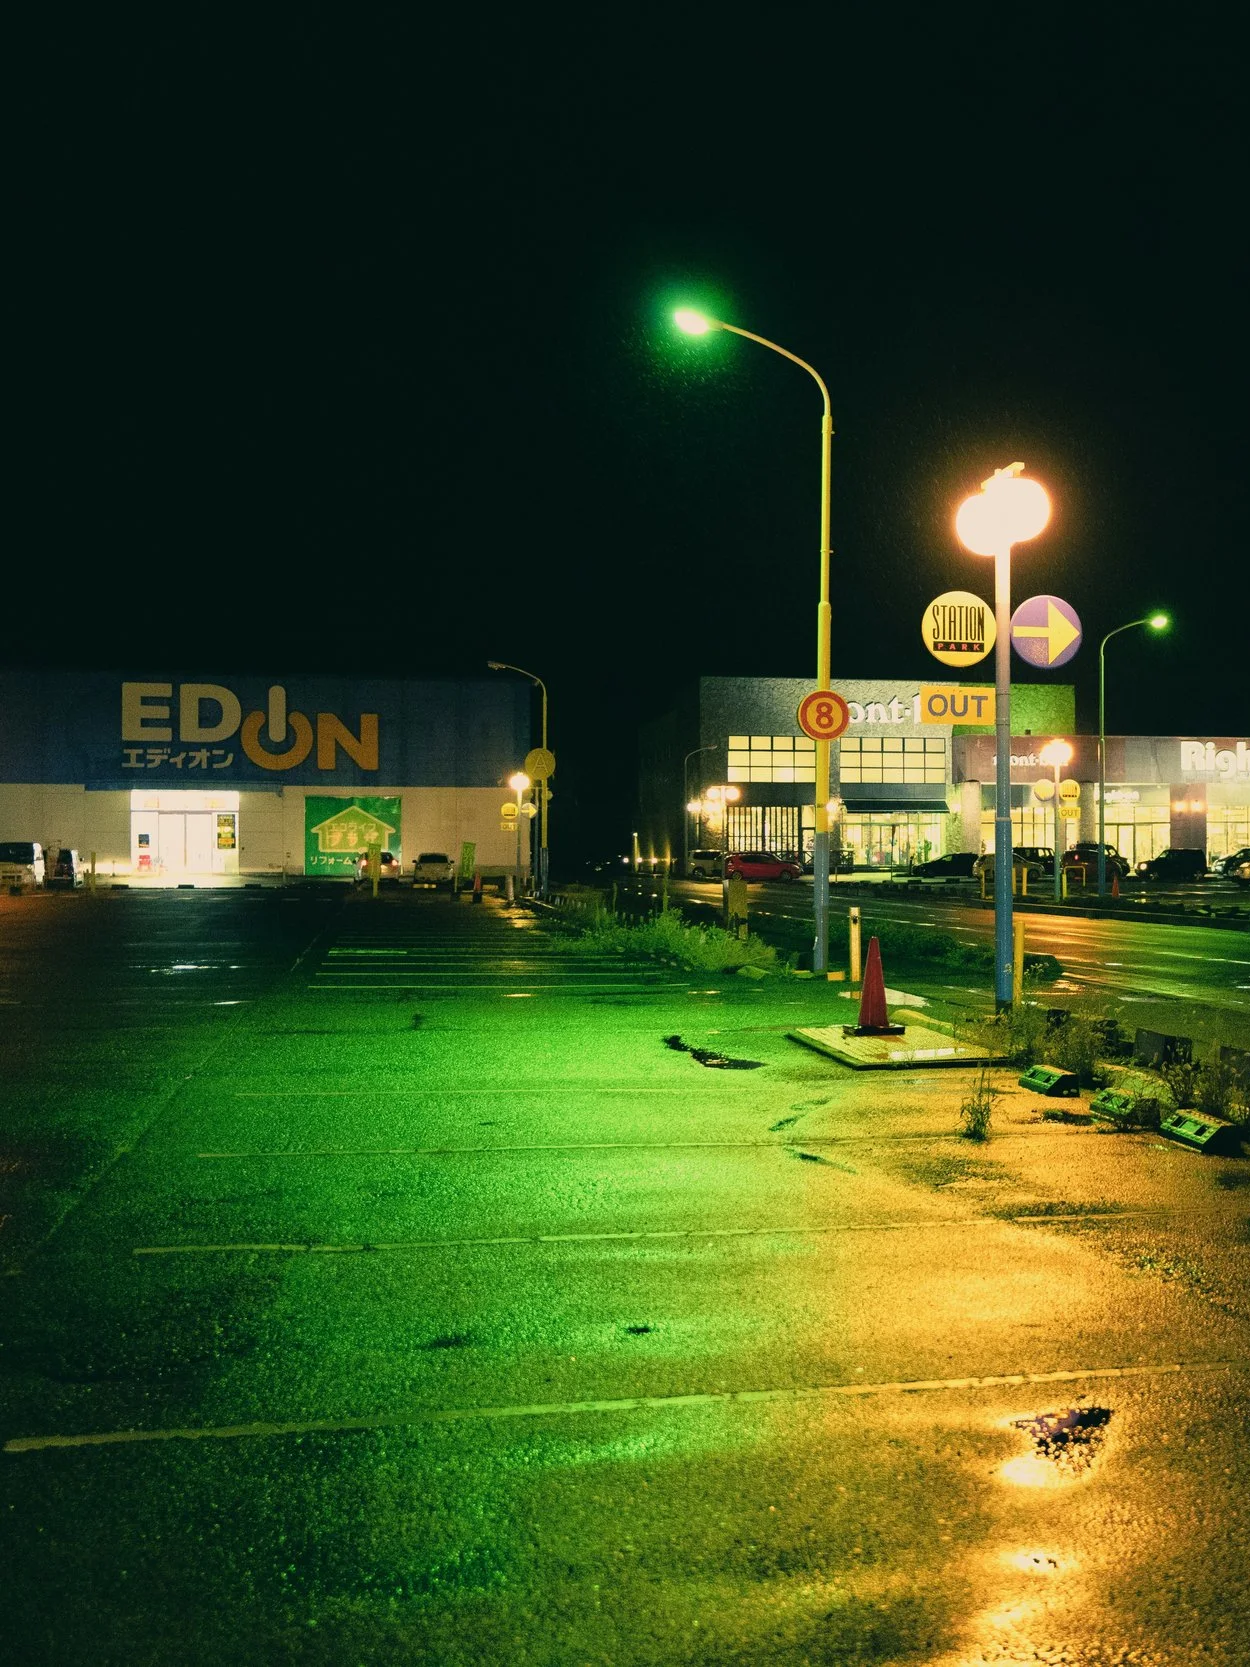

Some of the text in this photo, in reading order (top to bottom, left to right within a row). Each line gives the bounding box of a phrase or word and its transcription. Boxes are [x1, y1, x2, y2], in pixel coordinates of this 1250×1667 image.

[932, 604, 985, 641] STATION
[937, 642, 980, 650] PARK
[815, 702, 834, 729] 8
[928, 694, 989, 717] OUT
[121, 682, 379, 771] EDION
[121, 748, 234, 769] エディオン
[532, 753, 549, 774] A
[1061, 809, 1079, 817] OUT
